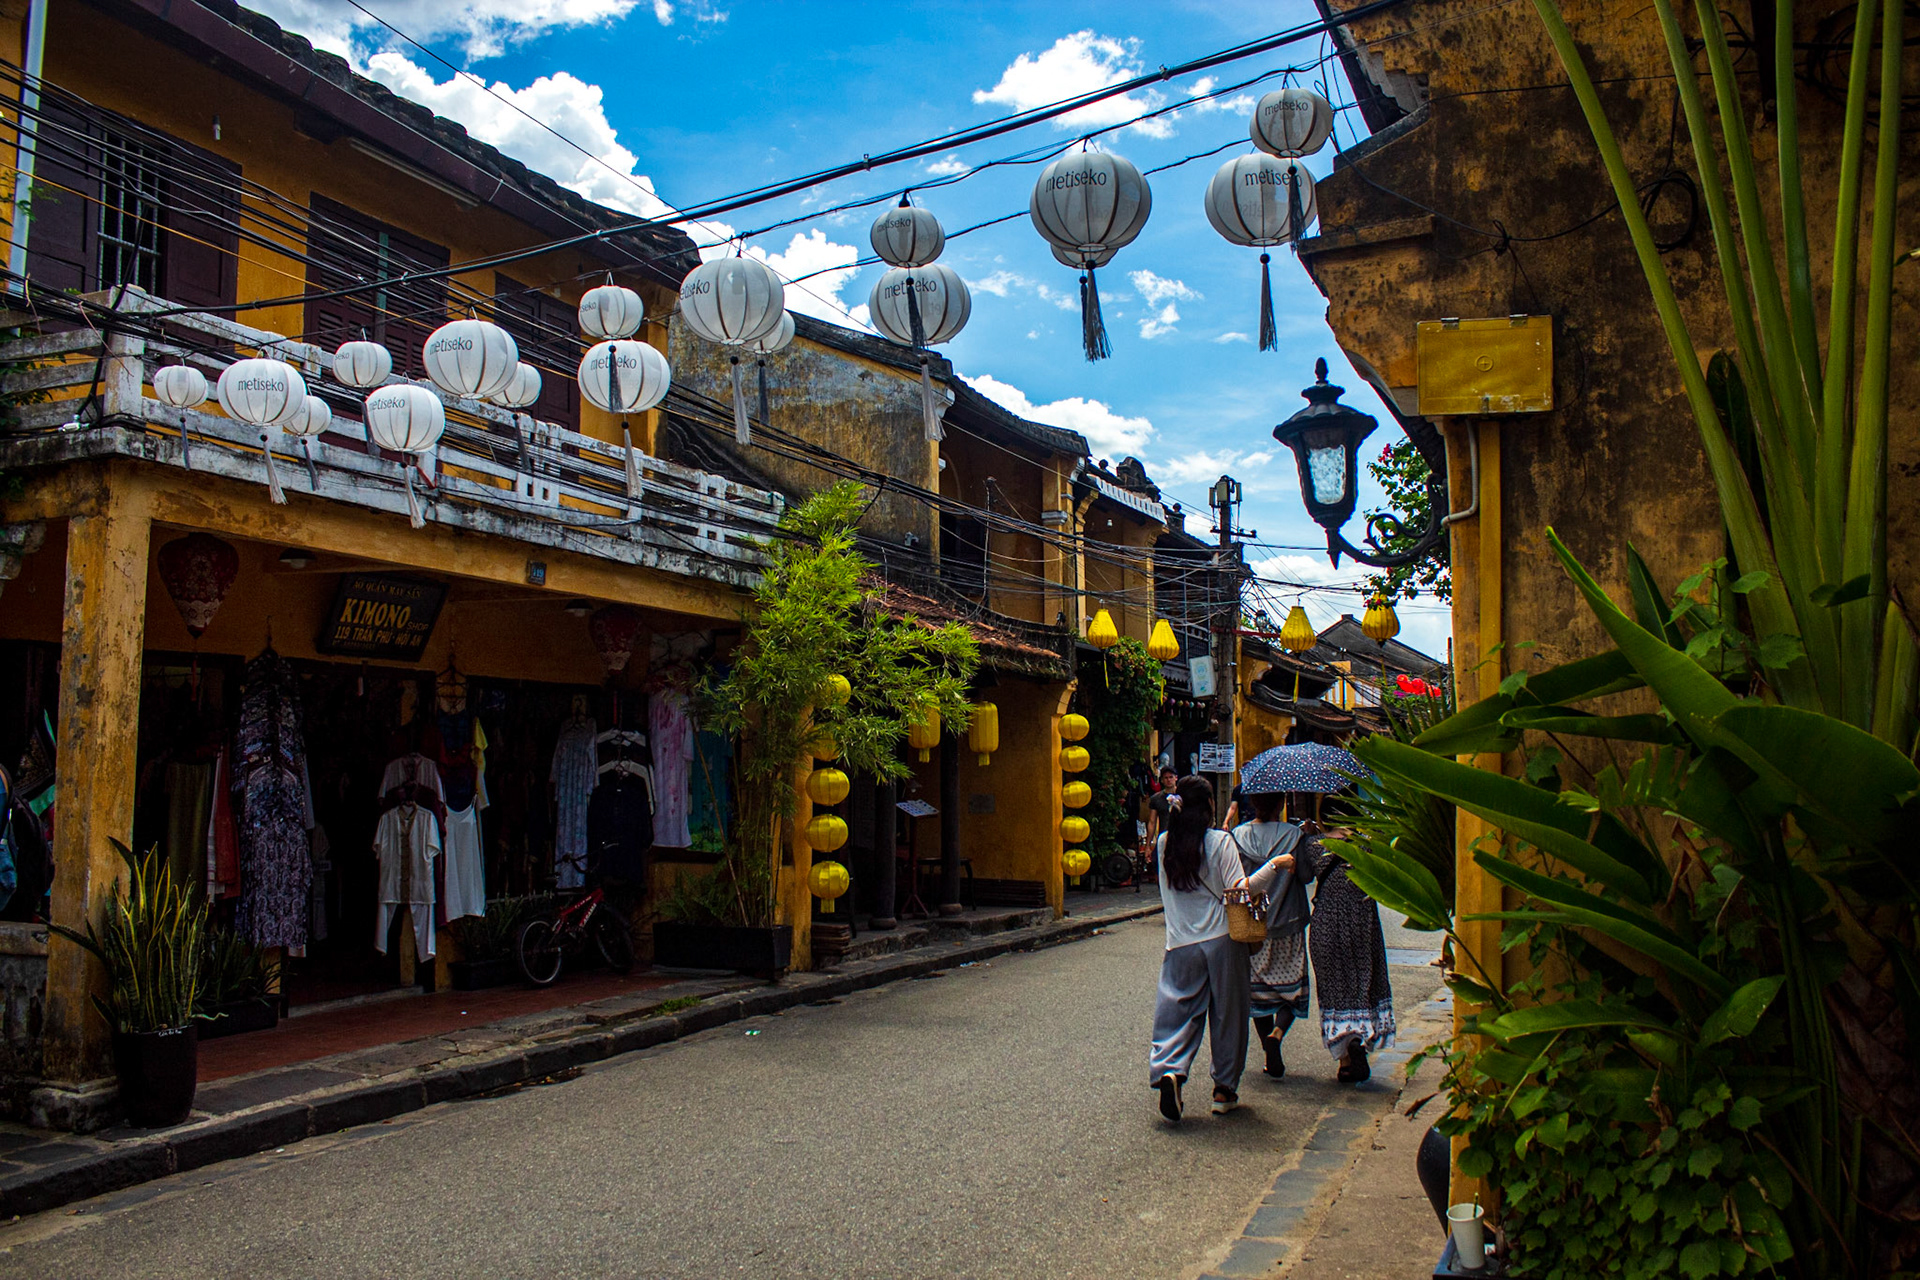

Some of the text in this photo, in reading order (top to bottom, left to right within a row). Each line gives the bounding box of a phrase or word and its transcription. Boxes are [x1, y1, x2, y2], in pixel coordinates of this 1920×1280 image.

[1264, 100, 1309, 116] metiseko
[1045, 168, 1107, 193] metiseko
[1245, 168, 1302, 188] metiseo
[884, 277, 937, 300] meteko
[430, 336, 474, 356] metiseko
[590, 354, 637, 371] meteko
[238, 378, 285, 393] metiseko
[339, 597, 412, 629] KIMONO
[334, 625, 351, 640] 119
[406, 621, 430, 632] SHOP
